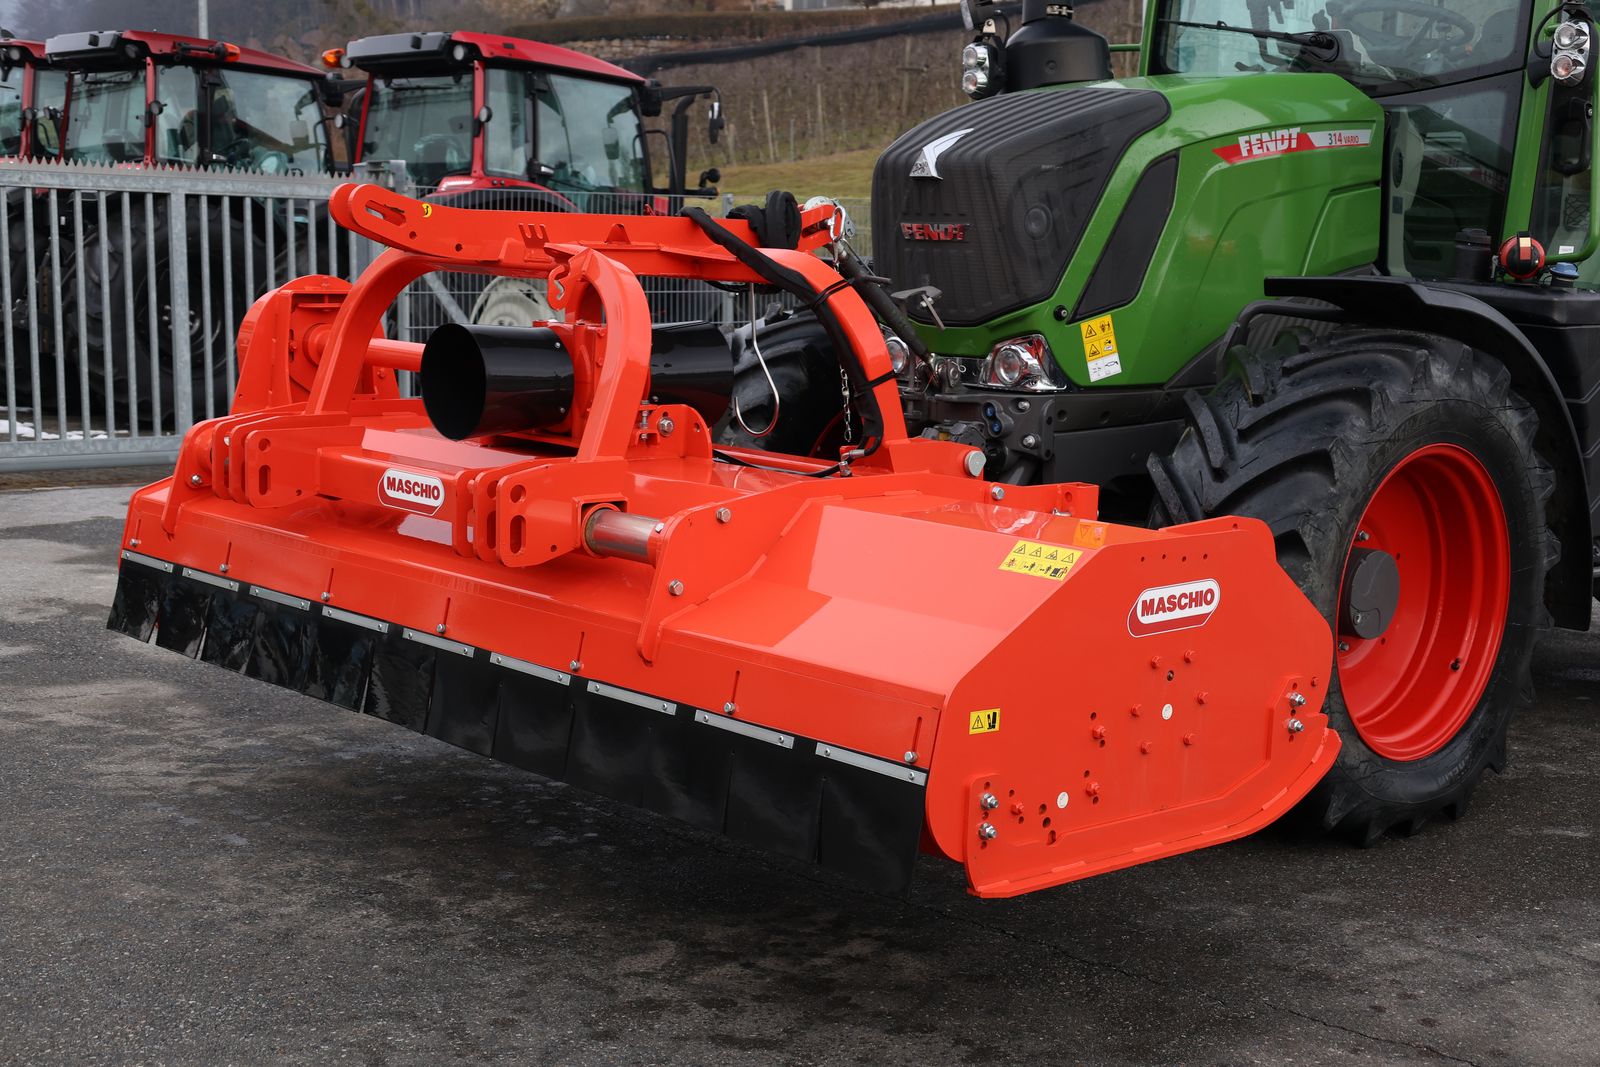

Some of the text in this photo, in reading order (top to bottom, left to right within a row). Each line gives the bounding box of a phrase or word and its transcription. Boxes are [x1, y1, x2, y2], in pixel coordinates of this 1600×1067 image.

[1238, 127, 1360, 157] FENDT 314 VARIO
[900, 223, 966, 241] FENDT
[386, 476, 441, 501] MASCHIO
[1141, 588, 1215, 617] MASCHIO
